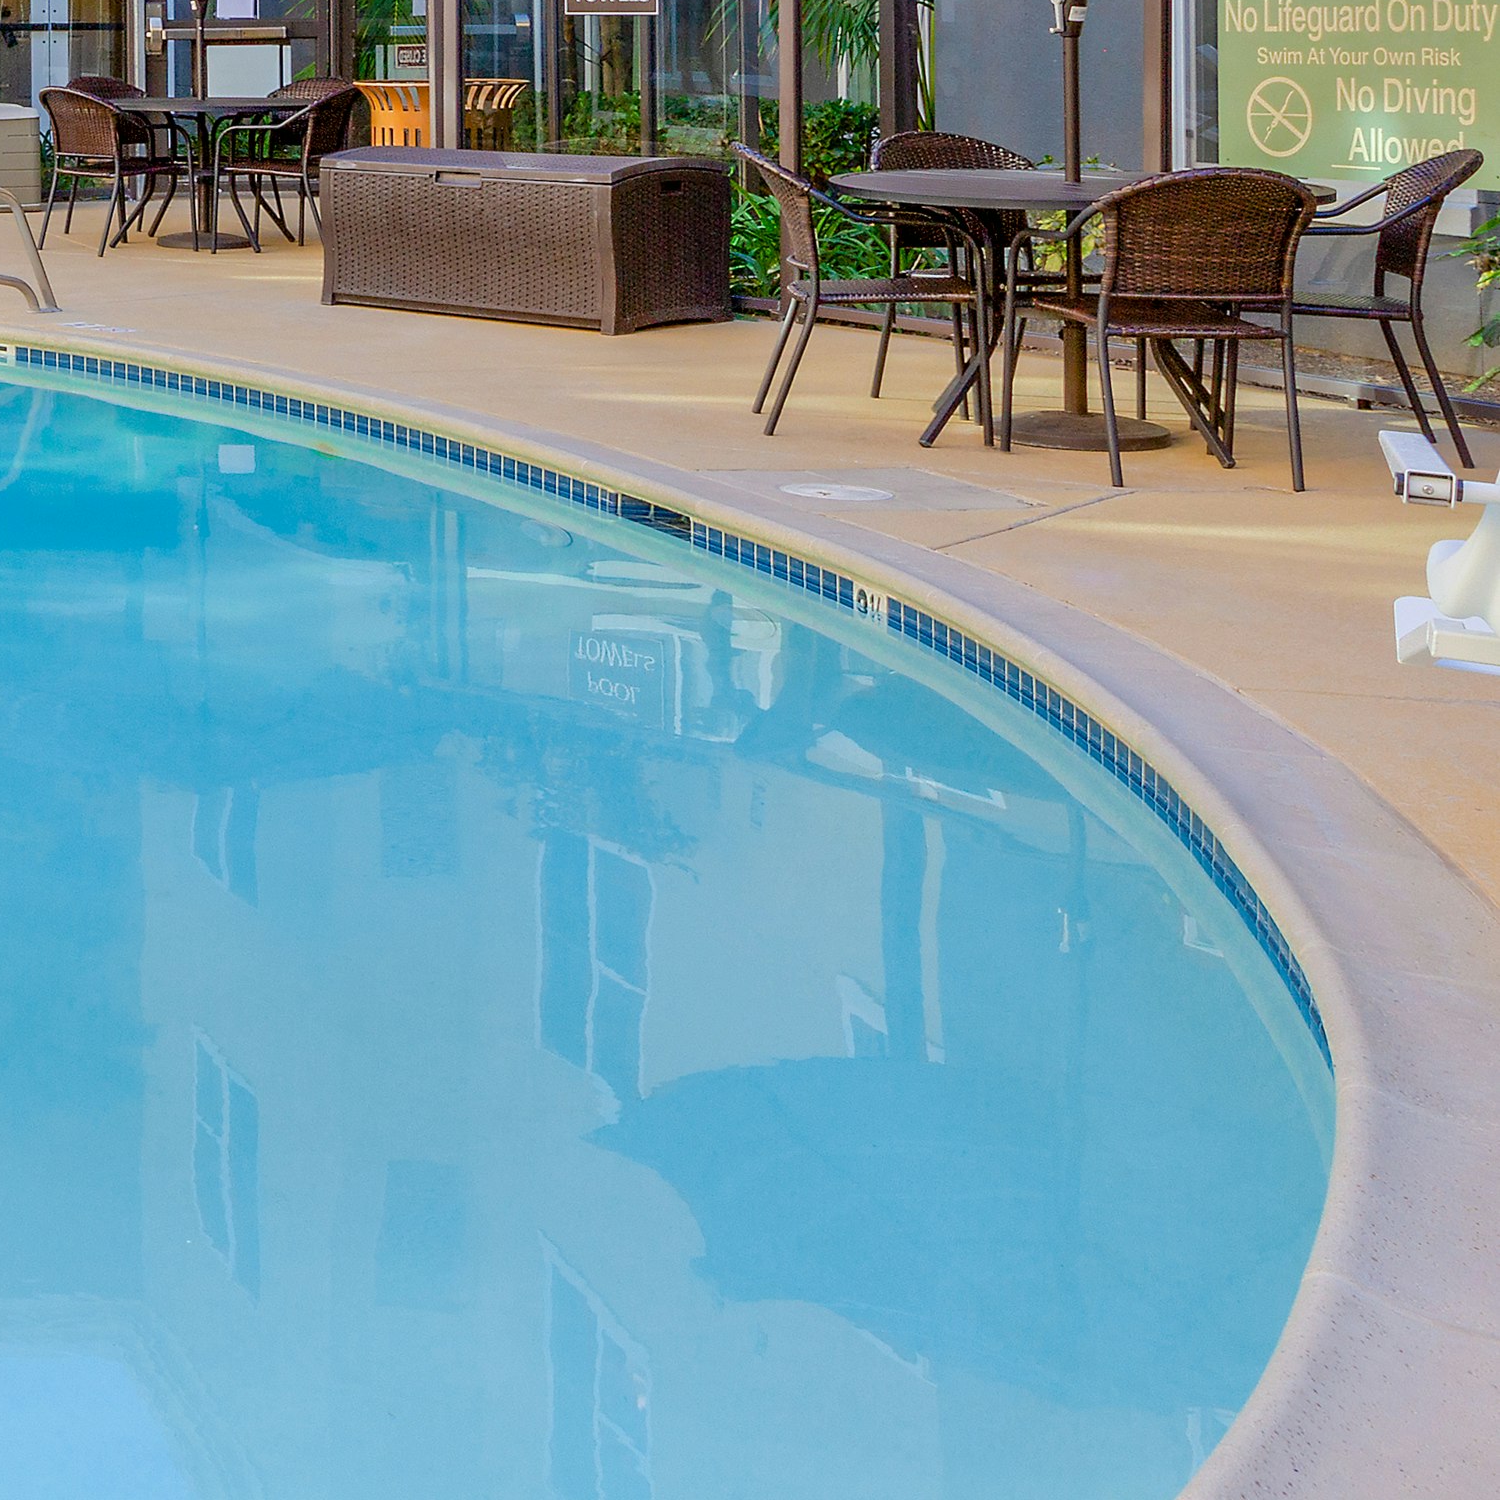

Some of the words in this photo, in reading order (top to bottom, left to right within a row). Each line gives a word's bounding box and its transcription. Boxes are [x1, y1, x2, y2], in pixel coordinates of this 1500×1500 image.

[1225, 0, 1257, 33] No
[1257, 47, 1302, 65] Swim
[1307, 48, 1325, 65] At
[1329, 48, 1368, 66] Your
[1373, 48, 1416, 66] Own
[1422, 48, 1462, 66] Risk
[1336, 77, 1375, 113] No
[1383, 78, 1476, 126] Diving
[1348, 127, 1464, 164] Allowed
